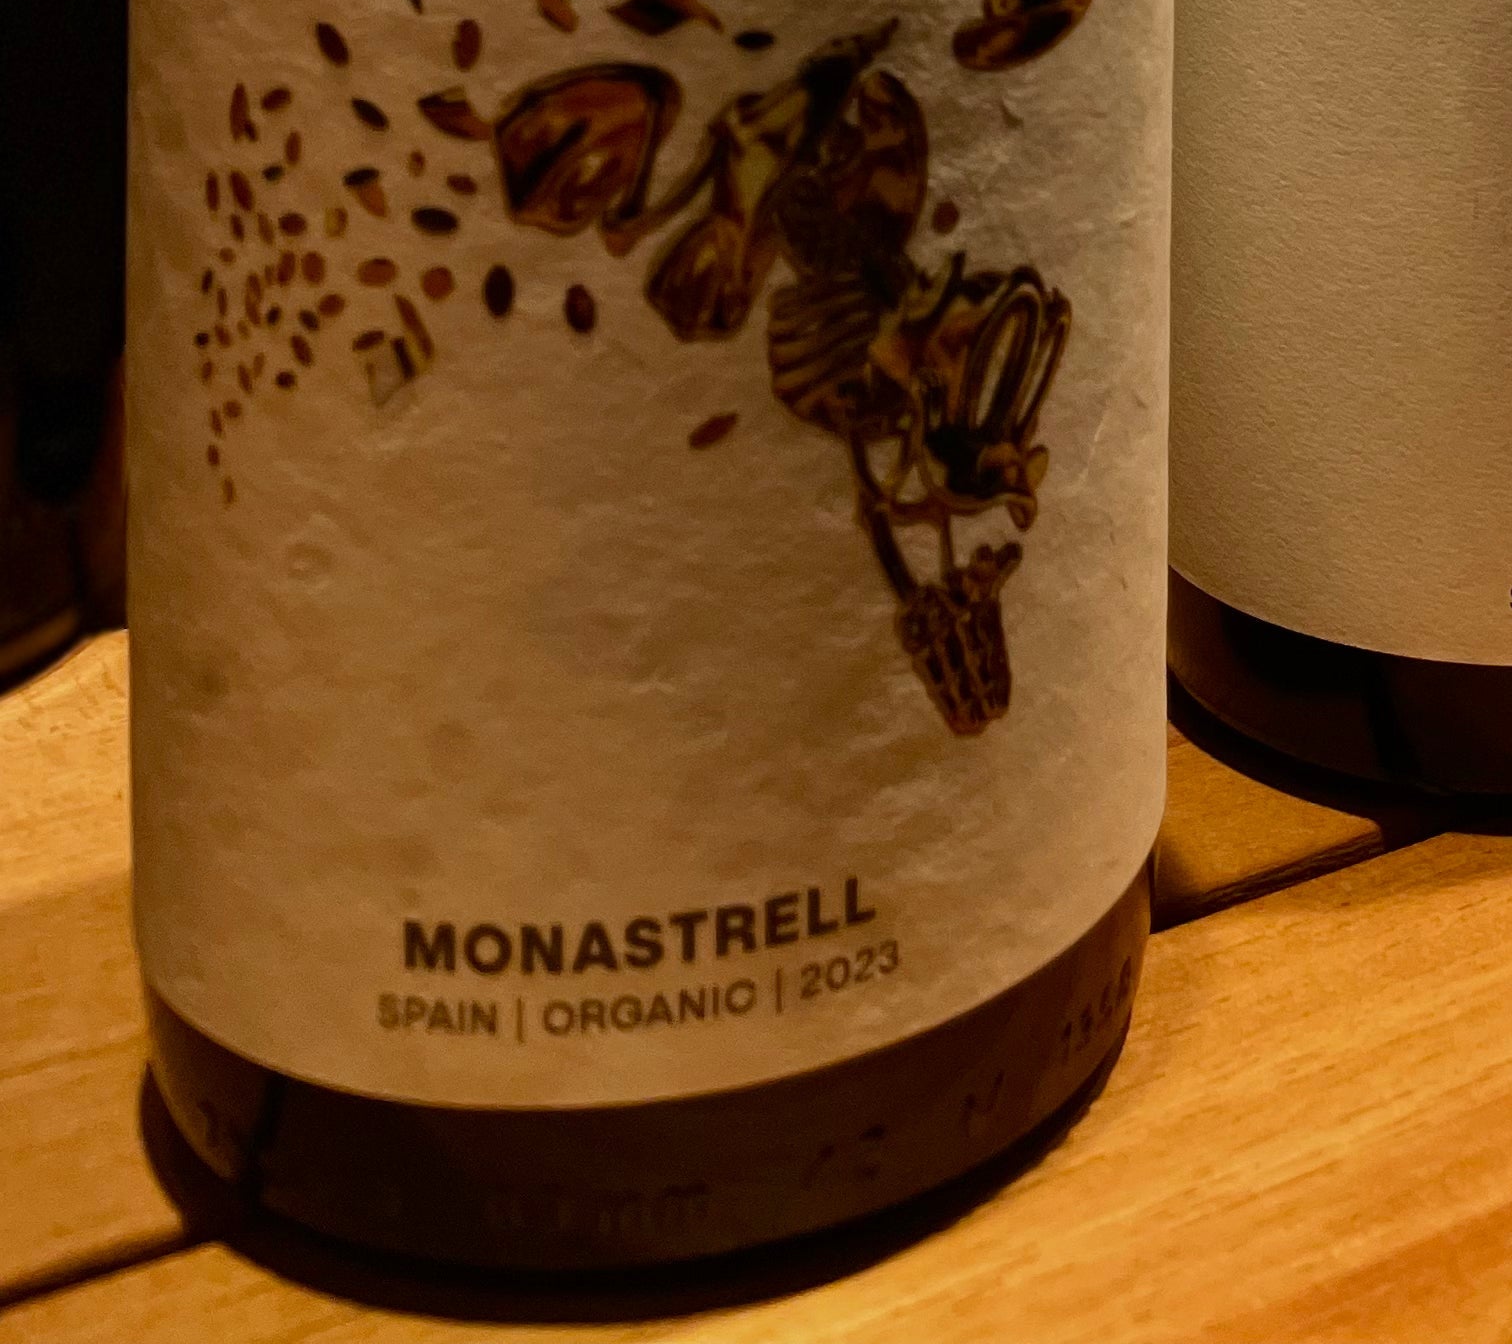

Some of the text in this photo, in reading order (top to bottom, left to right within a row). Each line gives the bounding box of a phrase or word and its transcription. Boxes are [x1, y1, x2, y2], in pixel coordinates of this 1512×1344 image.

[403, 874, 877, 976] MONASTRELL
[377, 939, 901, 1037] SPAIN ORGANIC 2023
